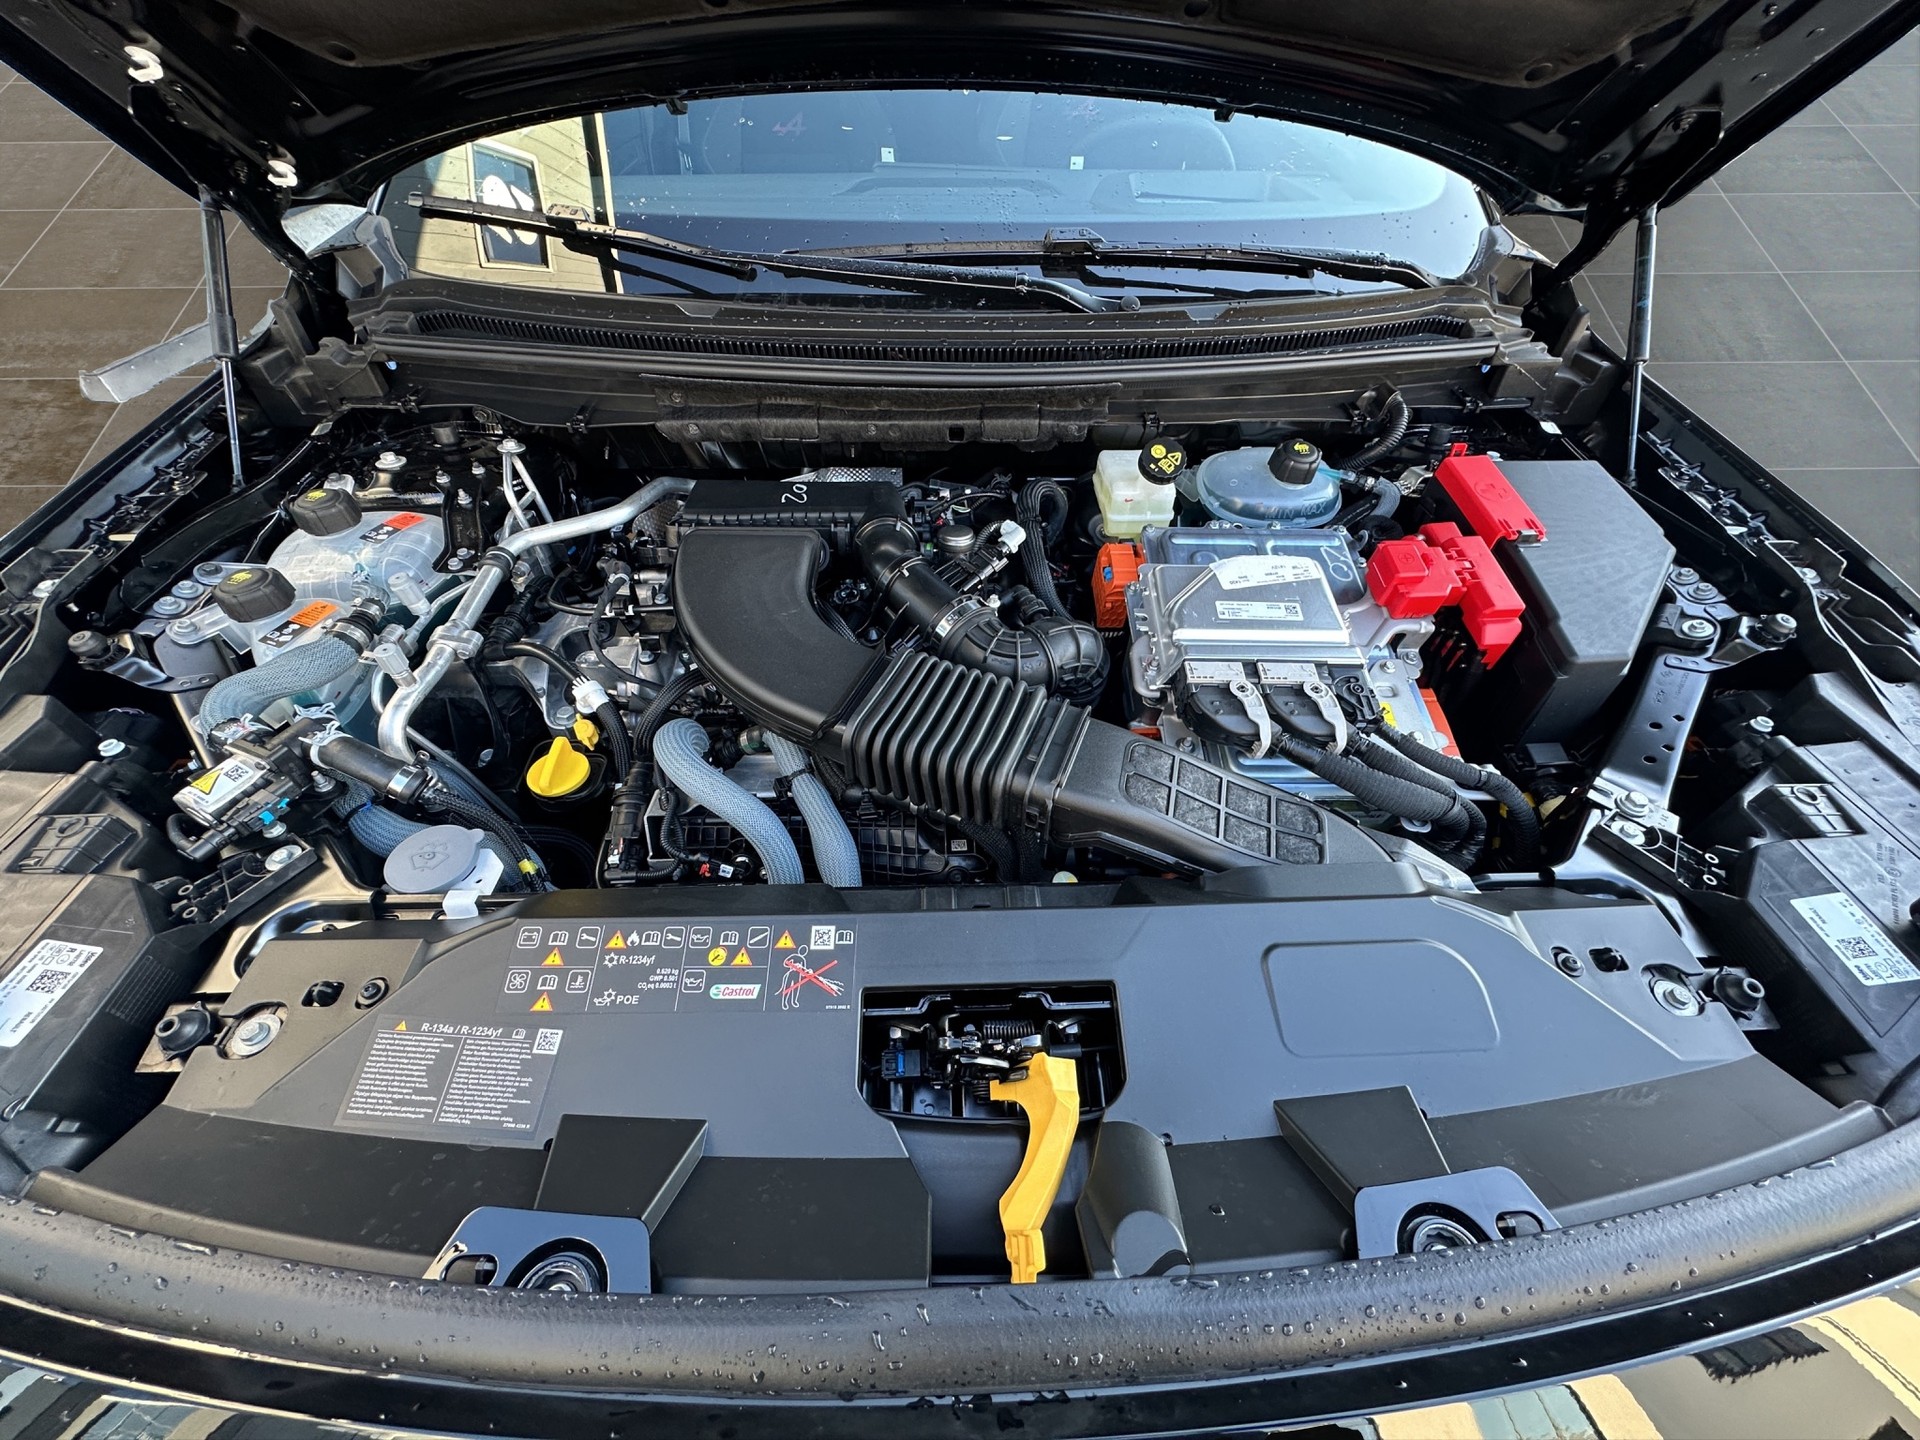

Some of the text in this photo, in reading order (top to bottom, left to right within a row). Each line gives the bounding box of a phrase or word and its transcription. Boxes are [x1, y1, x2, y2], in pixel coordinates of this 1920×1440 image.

[1265, 501, 1327, 519] MIN MAX
[78, 950, 99, 968] Valeo
[618, 953, 656, 967] R-1234yf
[649, 974, 662, 982] GWP
[722, 985, 756, 998] Castrol
[616, 994, 640, 1006] POE
[420, 1022, 454, 1034] R-134a
[460, 1025, 504, 1038] R-1234yf
